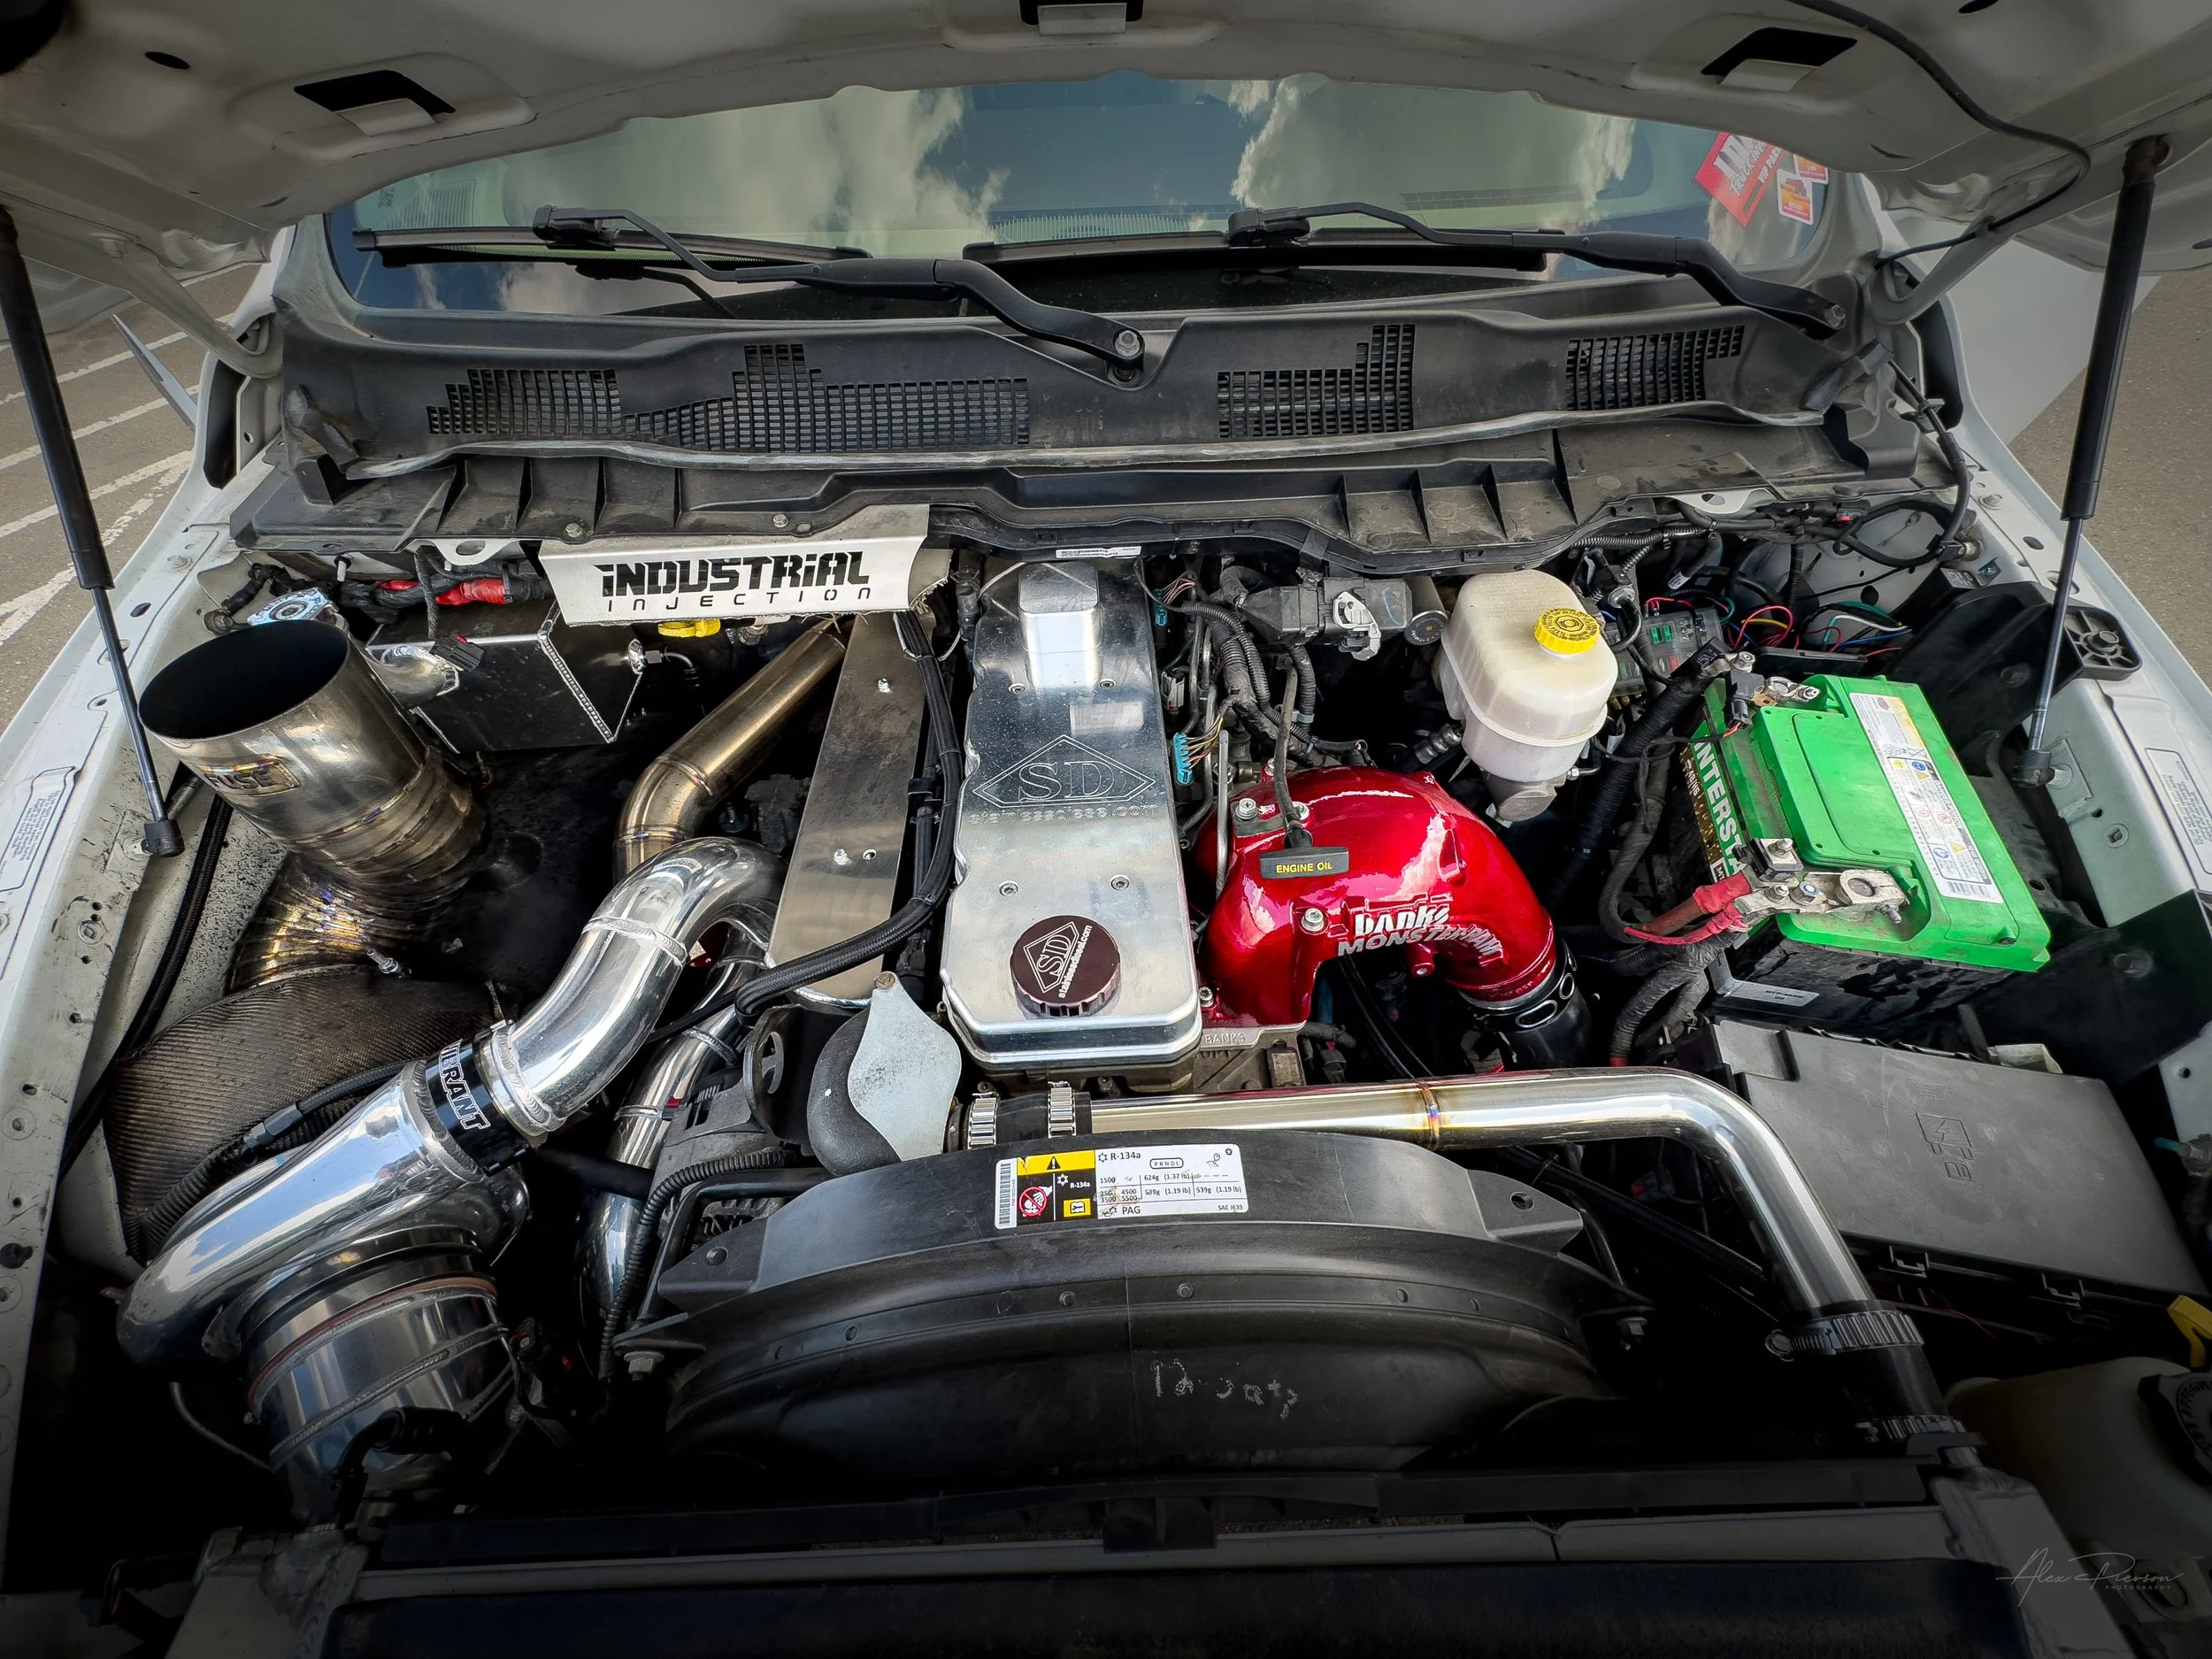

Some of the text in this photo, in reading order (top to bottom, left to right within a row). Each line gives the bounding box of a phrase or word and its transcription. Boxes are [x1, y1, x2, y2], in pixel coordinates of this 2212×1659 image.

[1729, 160, 1755, 196] TRUCK
[1757, 165, 1770, 184] VIP
[594, 551, 870, 597] INDUSTRIAL
[608, 588, 872, 612] INJECTION
[1018, 760, 1115, 802] SD
[1276, 861, 1333, 873] ENGINE OIL
[1036, 934, 1071, 977] SD
[1058, 925, 1093, 998] stainlessdiesel.com
[1204, 1032, 1246, 1044] BANKS
[1122, 1205, 1141, 1214] PAG
